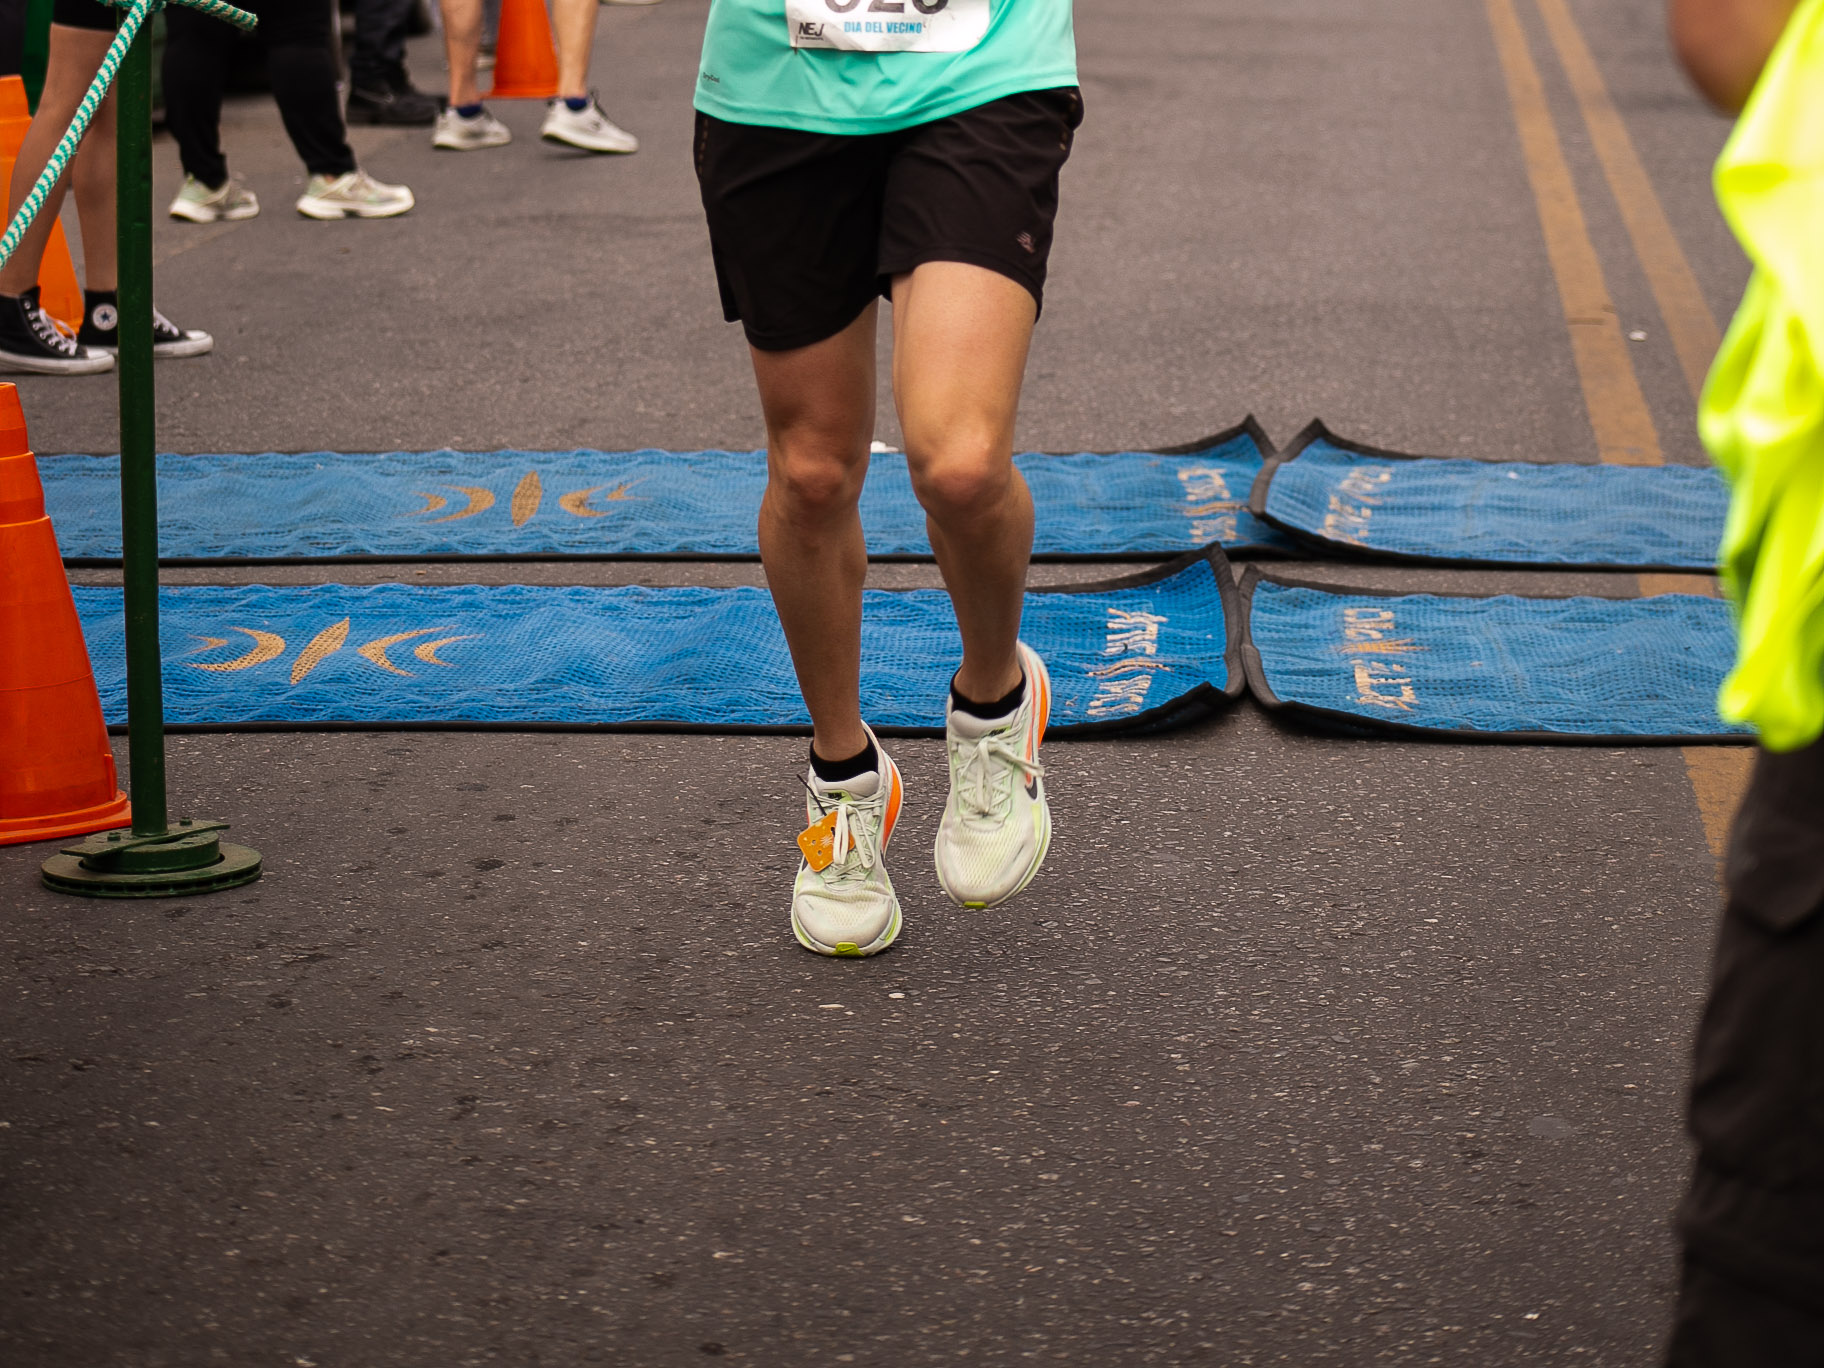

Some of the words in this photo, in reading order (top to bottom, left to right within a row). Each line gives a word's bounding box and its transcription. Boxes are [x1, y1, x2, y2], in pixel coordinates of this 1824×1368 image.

[844, 21, 861, 33] DIA
[865, 21, 883, 33] DEL
[886, 22, 923, 34] VECINO
